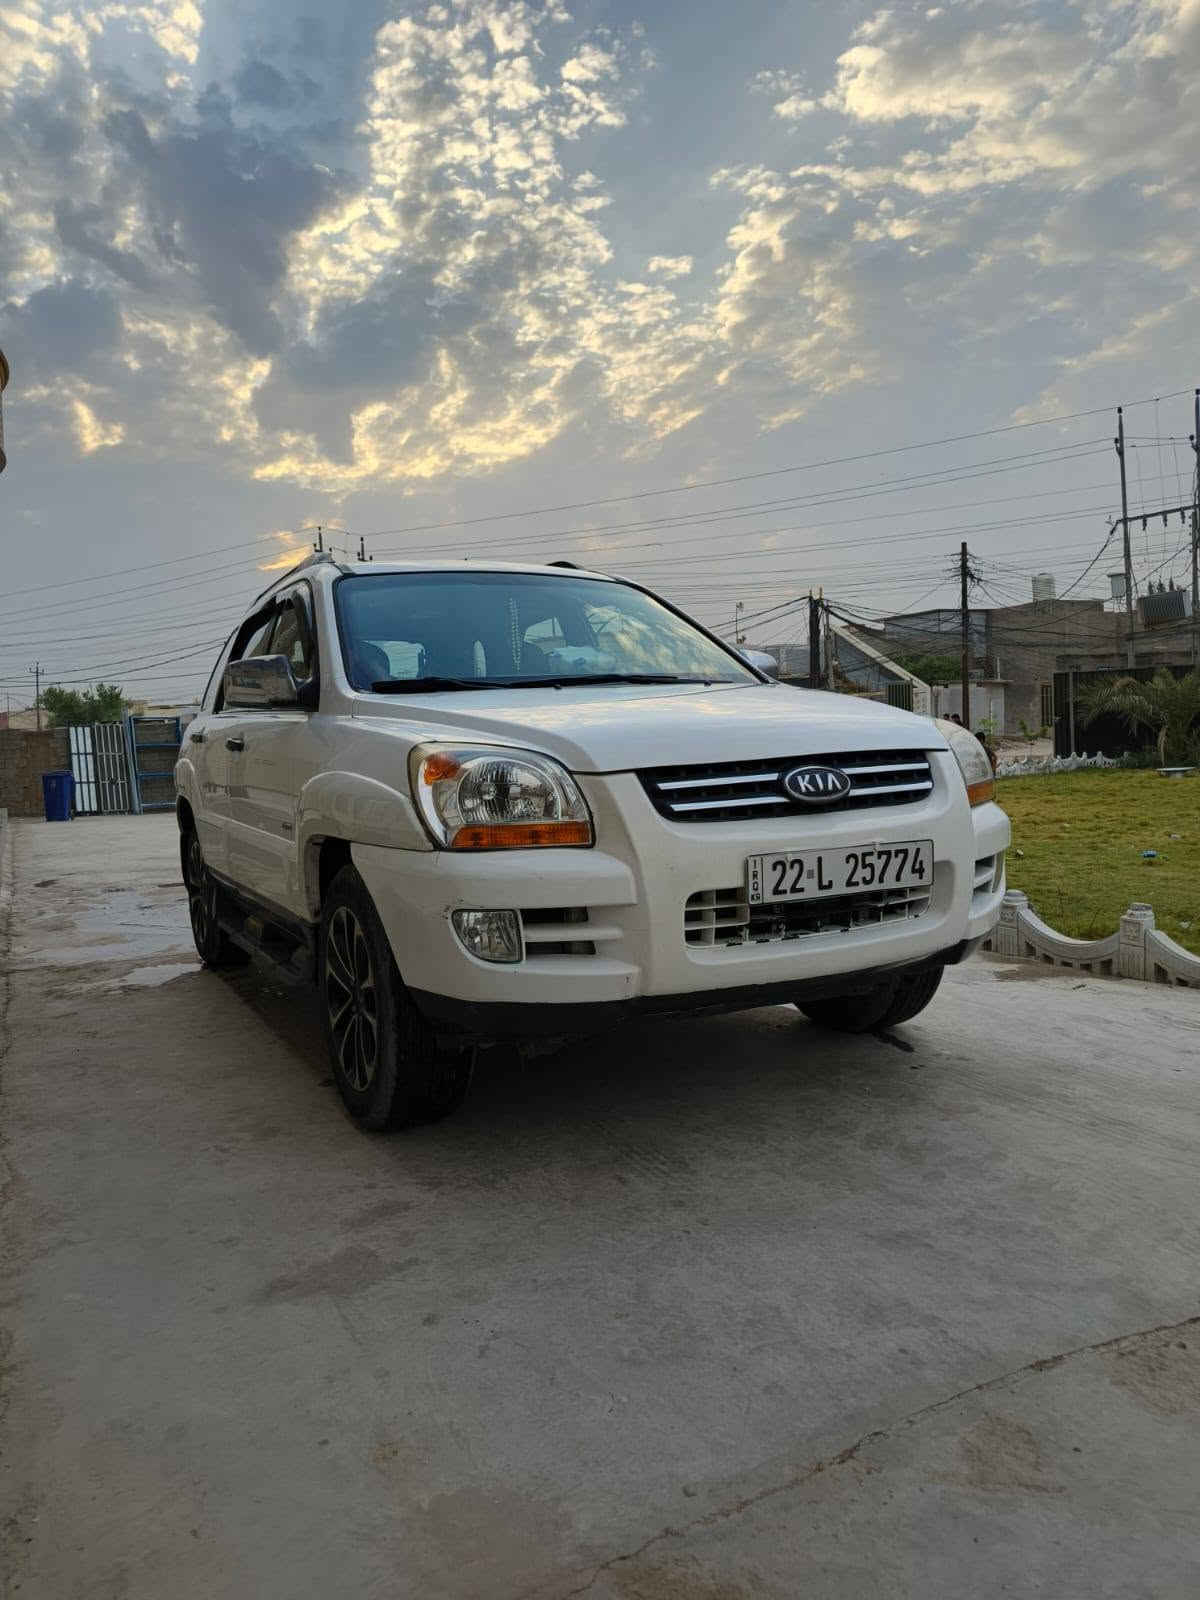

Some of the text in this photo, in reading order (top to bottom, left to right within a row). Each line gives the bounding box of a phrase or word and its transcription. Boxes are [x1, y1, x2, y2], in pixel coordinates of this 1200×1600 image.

[797, 772, 842, 792] KIA
[772, 847, 925, 896] 22 L 25774
